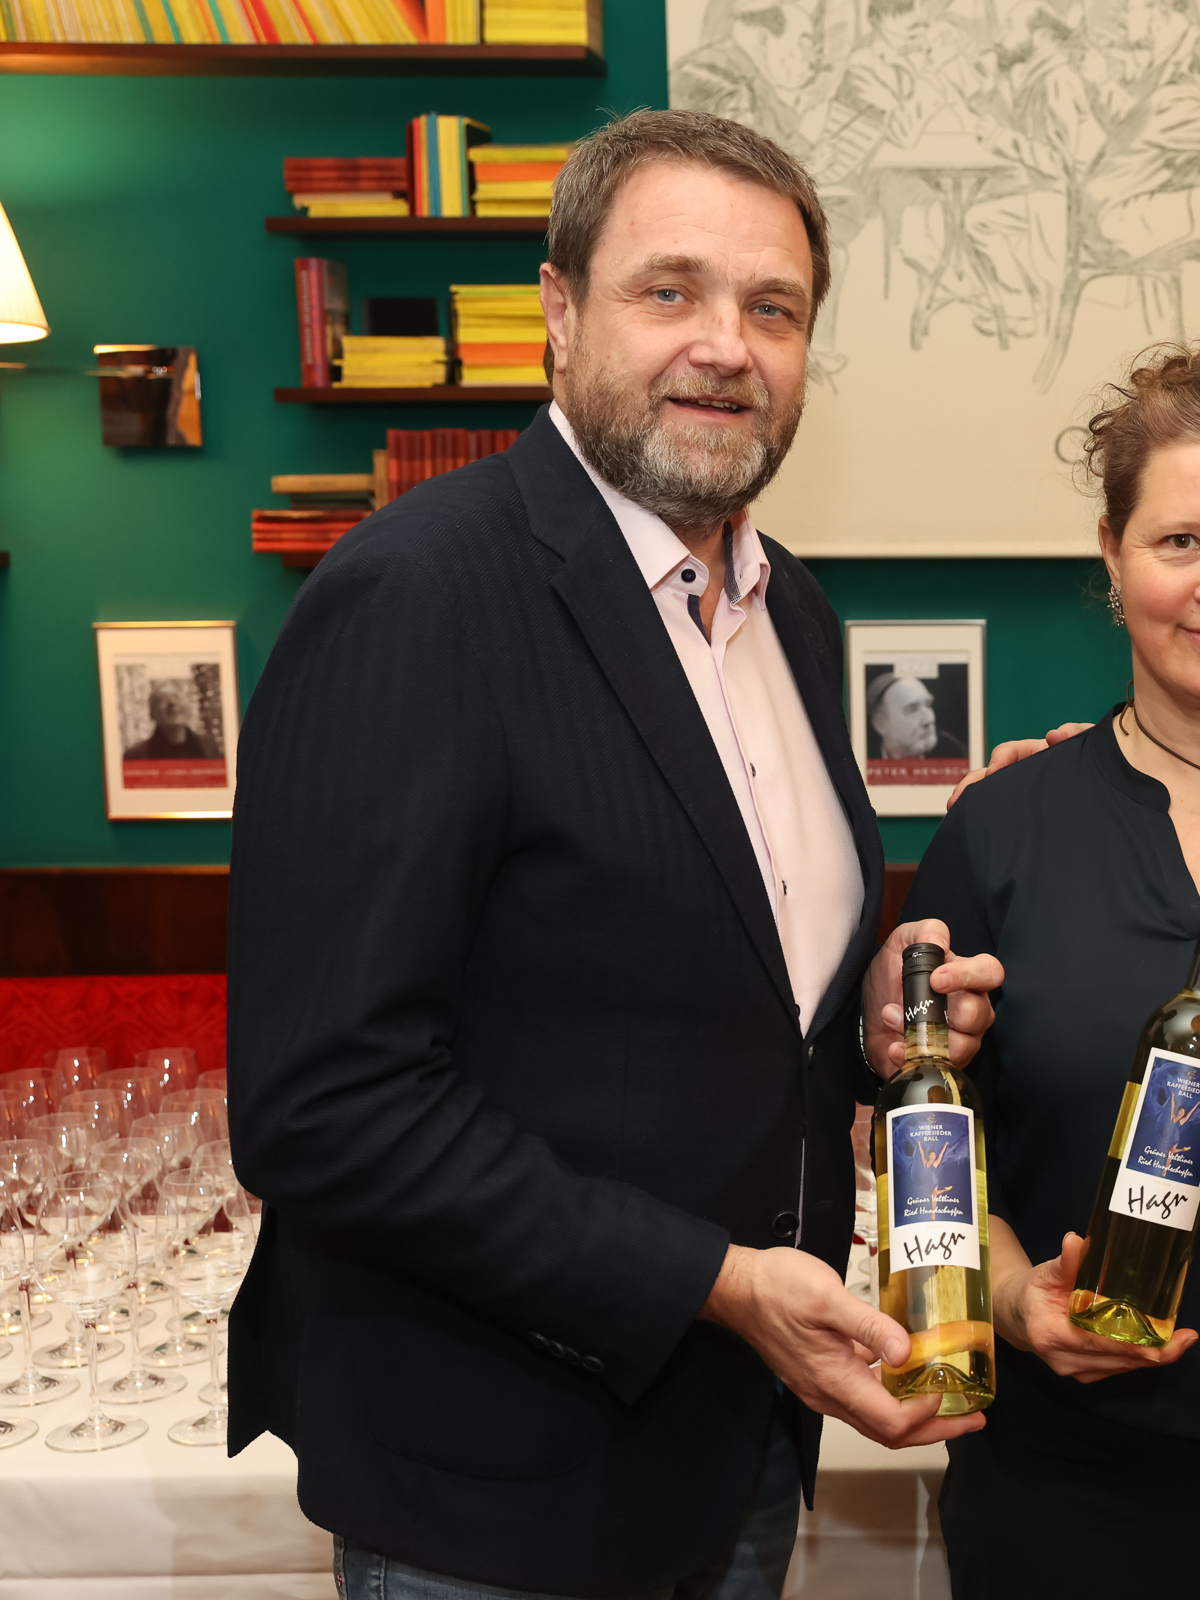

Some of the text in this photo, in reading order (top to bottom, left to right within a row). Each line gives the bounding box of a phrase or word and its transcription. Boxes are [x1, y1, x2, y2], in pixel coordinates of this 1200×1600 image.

[868, 767, 908, 776] PETER
[1177, 1077, 1200, 1088] WIENER
[1178, 1090, 1193, 1098] BALL
[1137, 1155, 1152, 1166] Ried
[1128, 1185, 1188, 1219] Hagn
[904, 1207, 919, 1217] Ried
[903, 1231, 966, 1265] Hagn
